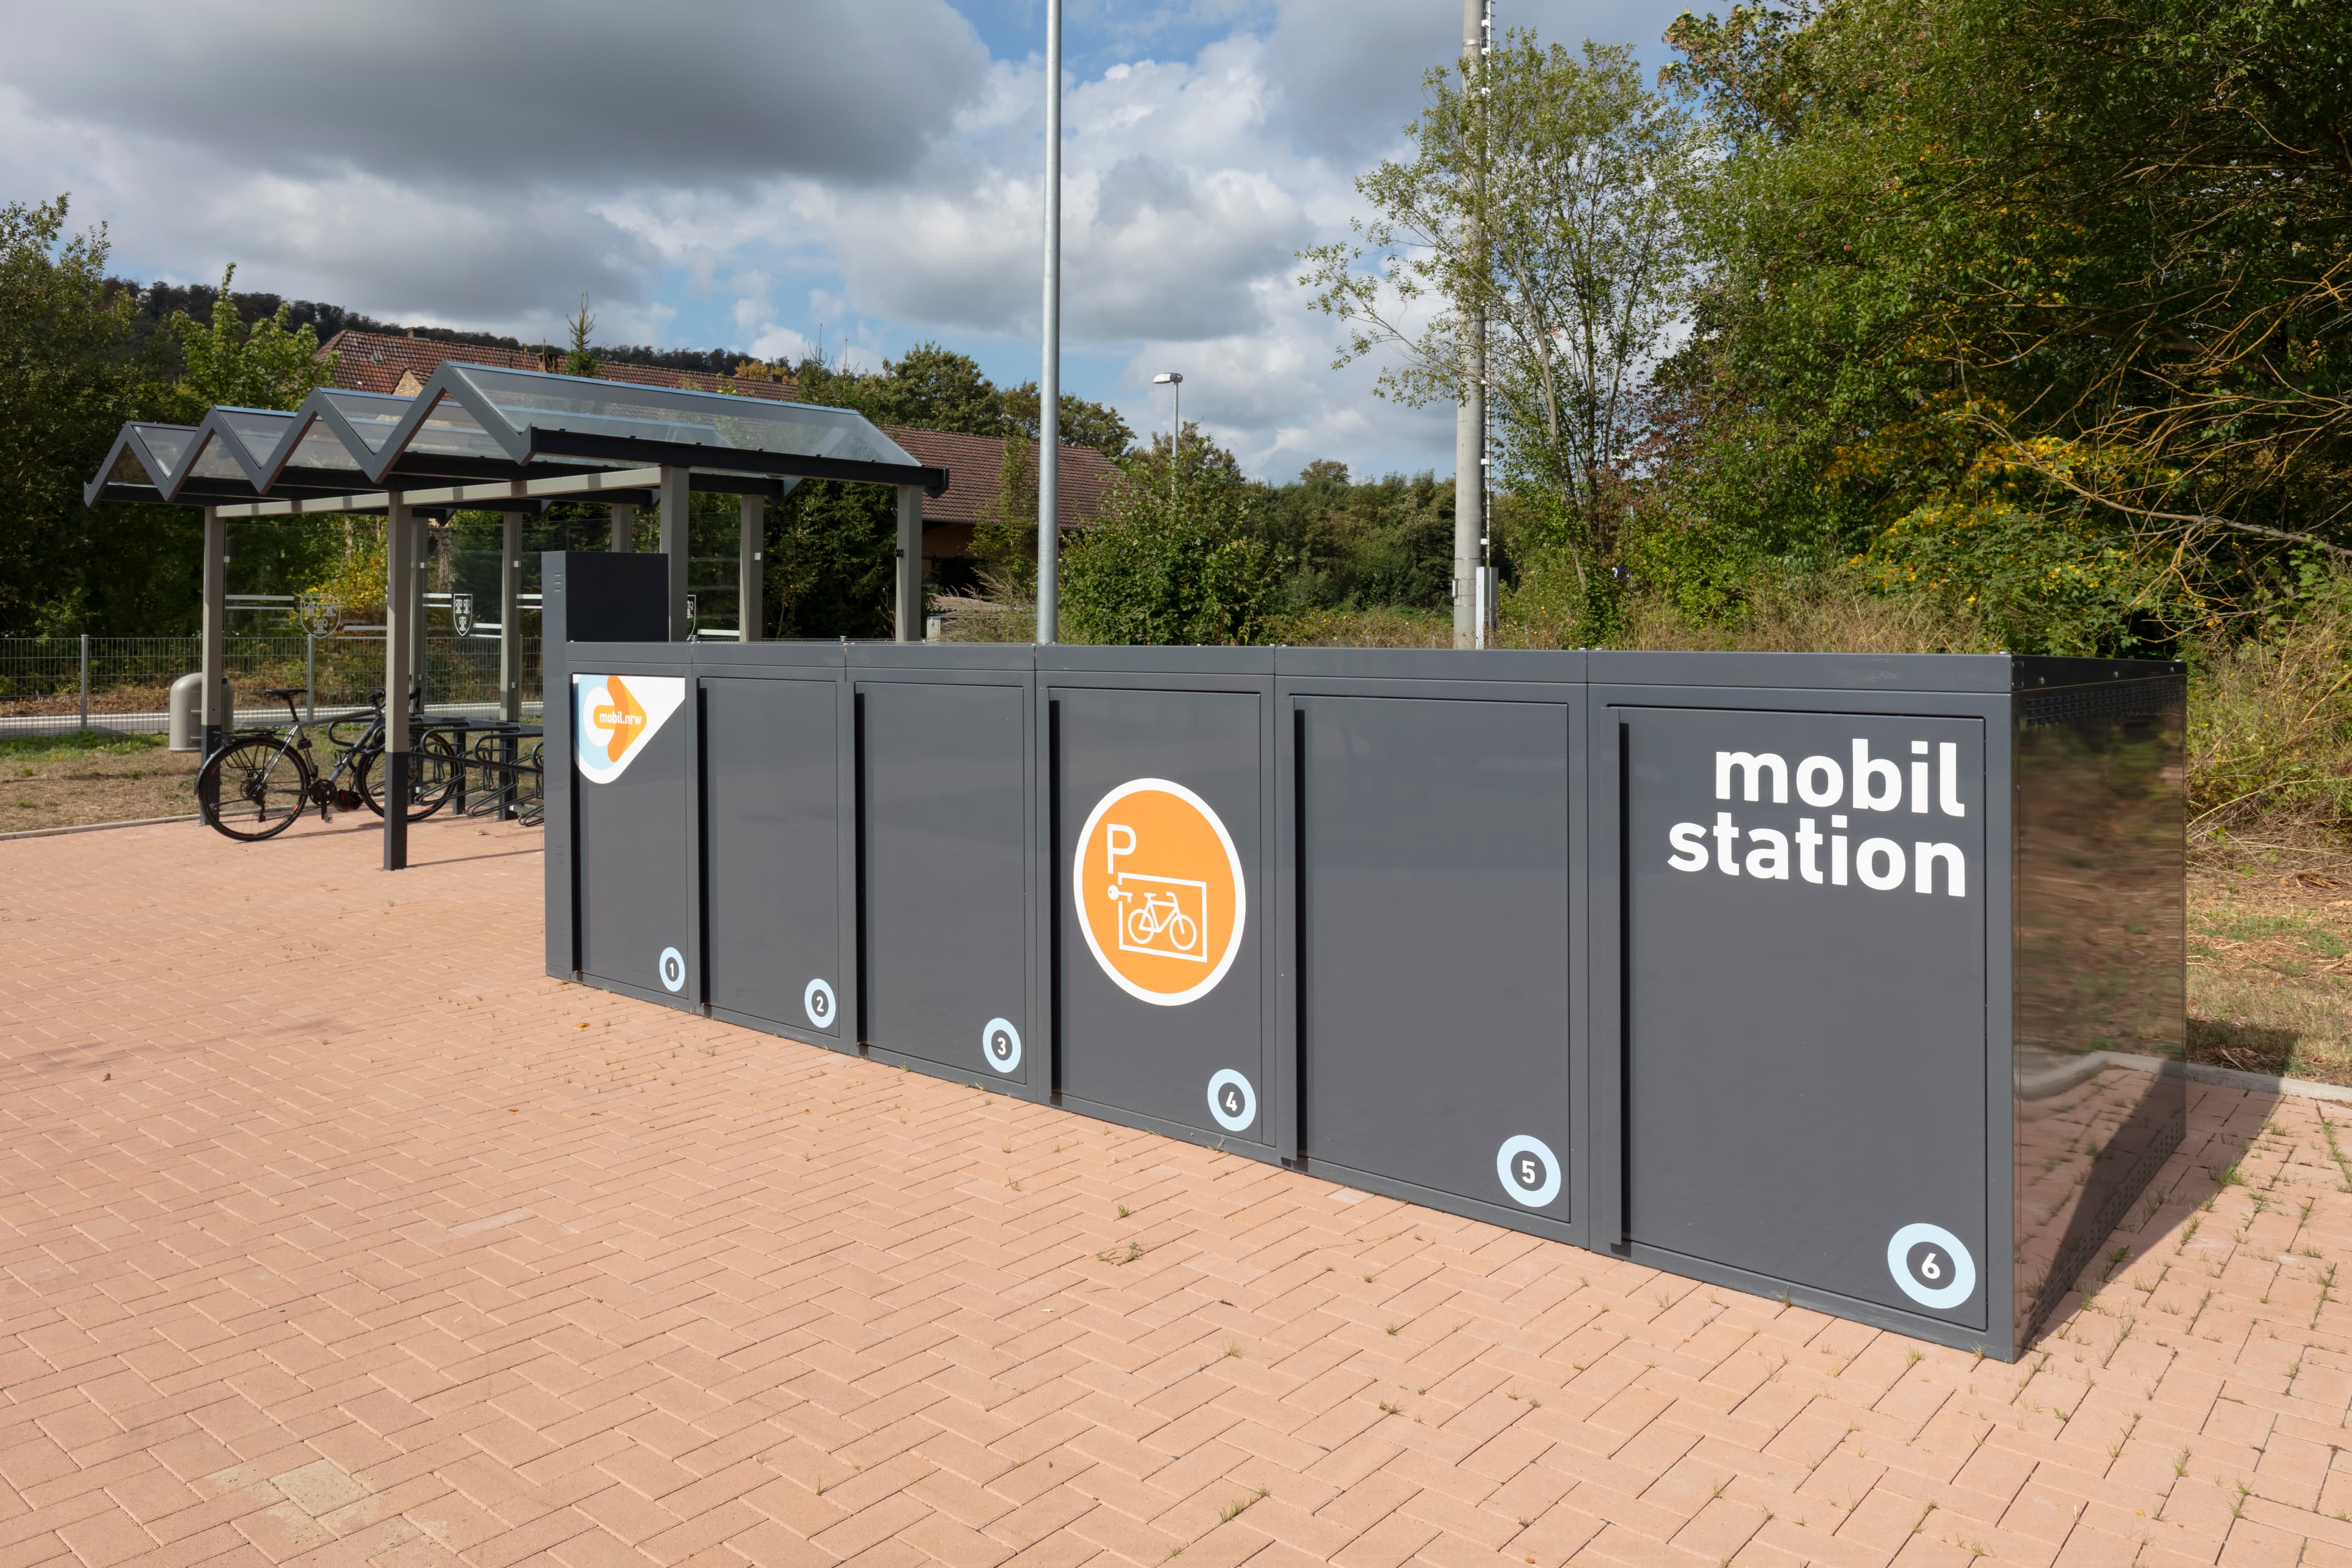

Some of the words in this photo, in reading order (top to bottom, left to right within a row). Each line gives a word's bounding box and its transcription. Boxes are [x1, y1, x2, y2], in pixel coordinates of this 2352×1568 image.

[600, 710, 642, 725] mobil.nrw
[1716, 739, 1965, 817] mobil
[1107, 823, 1137, 874] P
[1667, 812, 1966, 897] station
[669, 963, 674, 978] 1
[816, 996, 824, 1012] 2
[997, 1037, 1006, 1055] 3
[1226, 1091, 1237, 1112] 4
[1522, 1159, 1536, 1184] 5
[1921, 1253, 1940, 1280] 6
